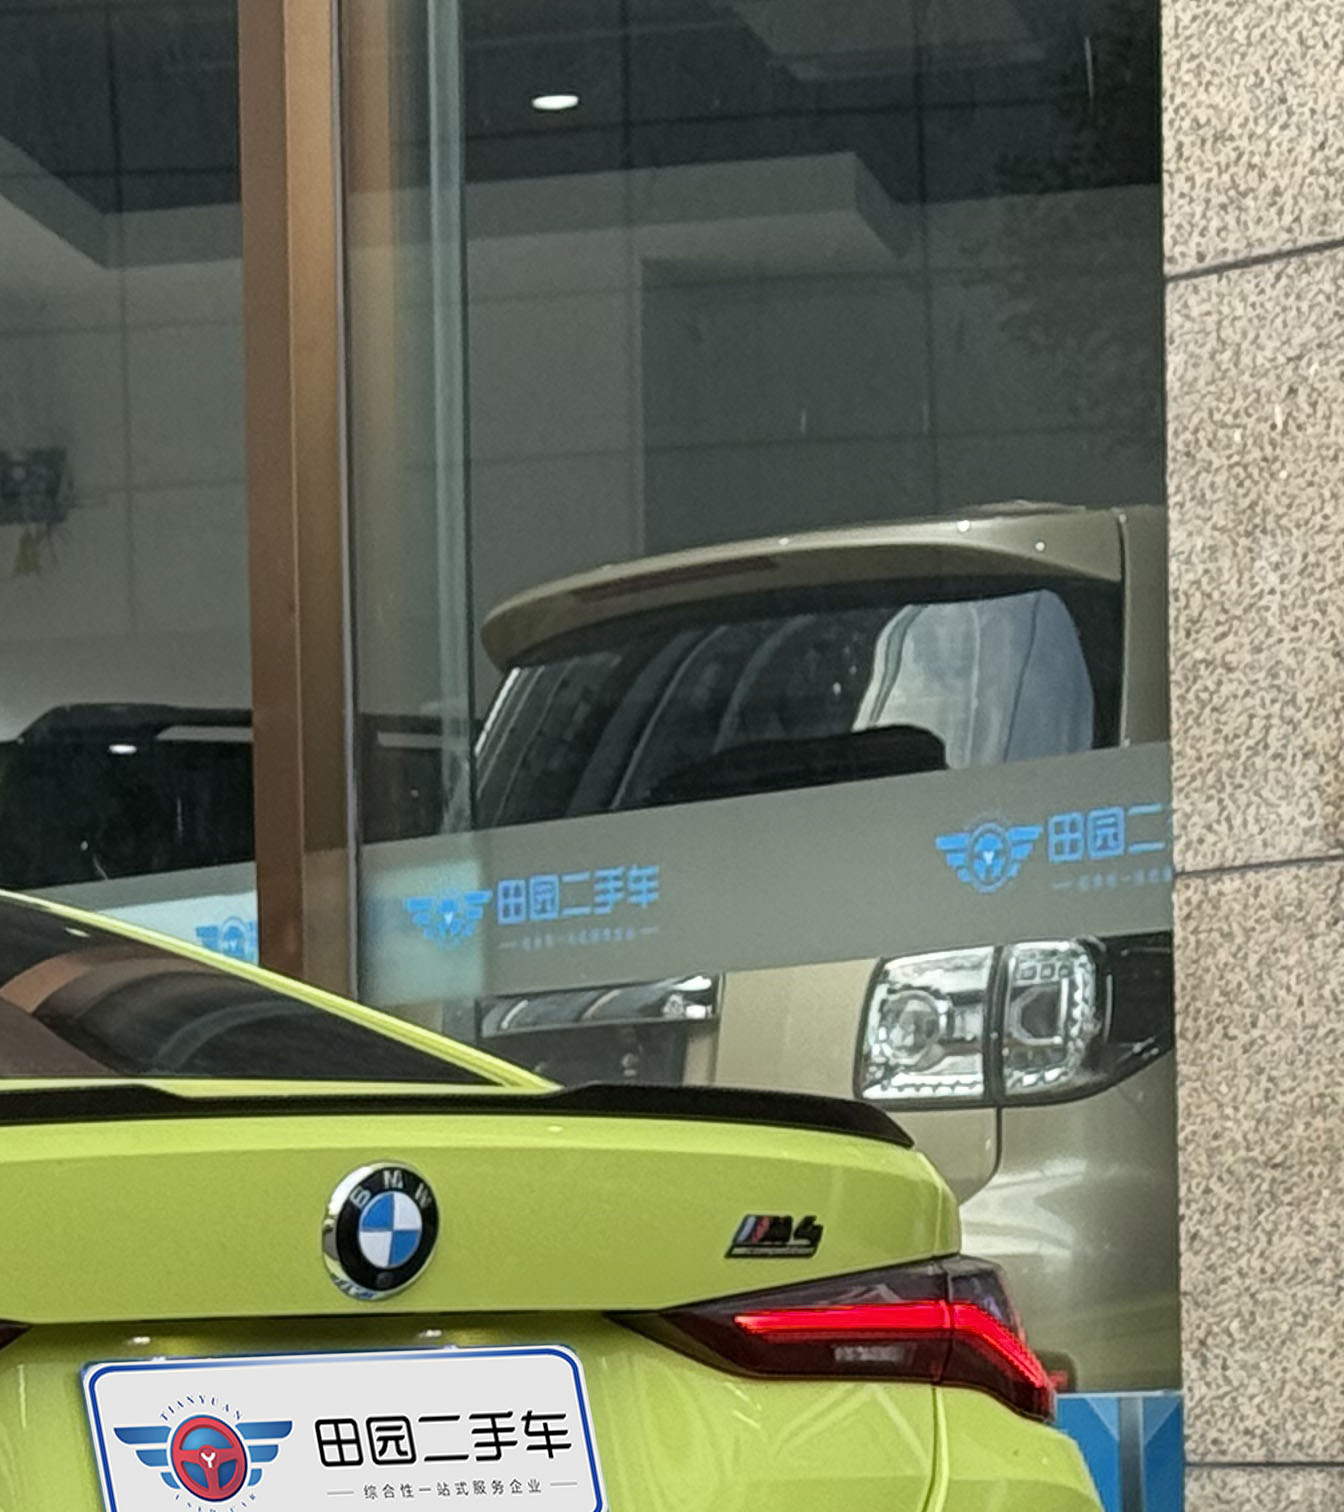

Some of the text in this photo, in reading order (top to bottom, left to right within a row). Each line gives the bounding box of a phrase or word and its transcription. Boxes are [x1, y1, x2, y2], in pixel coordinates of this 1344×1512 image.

[1047, 803, 1172, 863] 田园二
[497, 865, 660, 926] 田园二手车
[349, 1169, 432, 1209] BMW
[314, 1410, 572, 1467] 田园二手车
[363, 1479, 542, 1500] 综合性一站式服务企业
